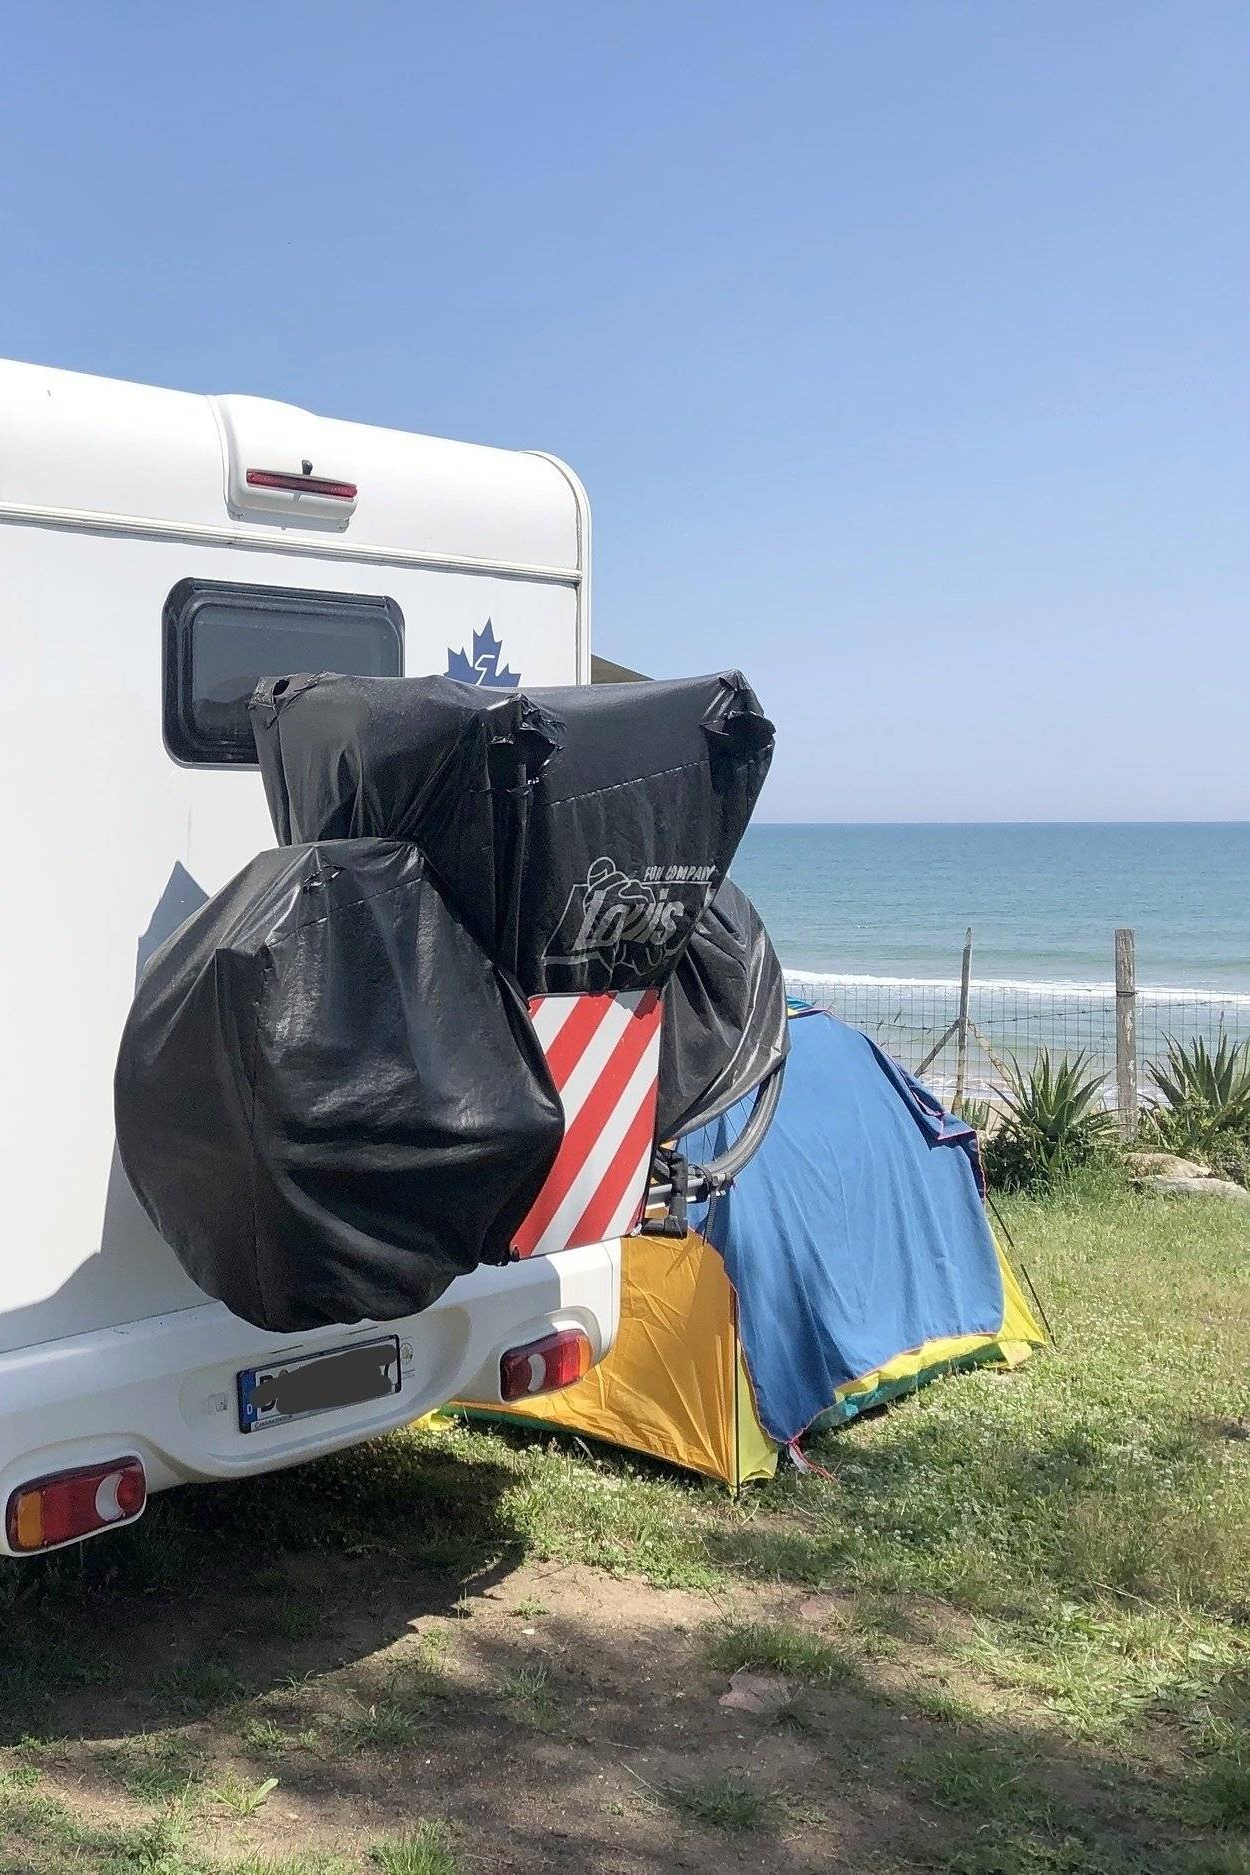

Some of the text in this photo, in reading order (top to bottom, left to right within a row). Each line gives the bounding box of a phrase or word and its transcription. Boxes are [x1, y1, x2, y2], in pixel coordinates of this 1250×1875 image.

[665, 864, 715, 880] COMPANY
[571, 888, 684, 951] Louis
[246, 1404, 253, 1415] D
